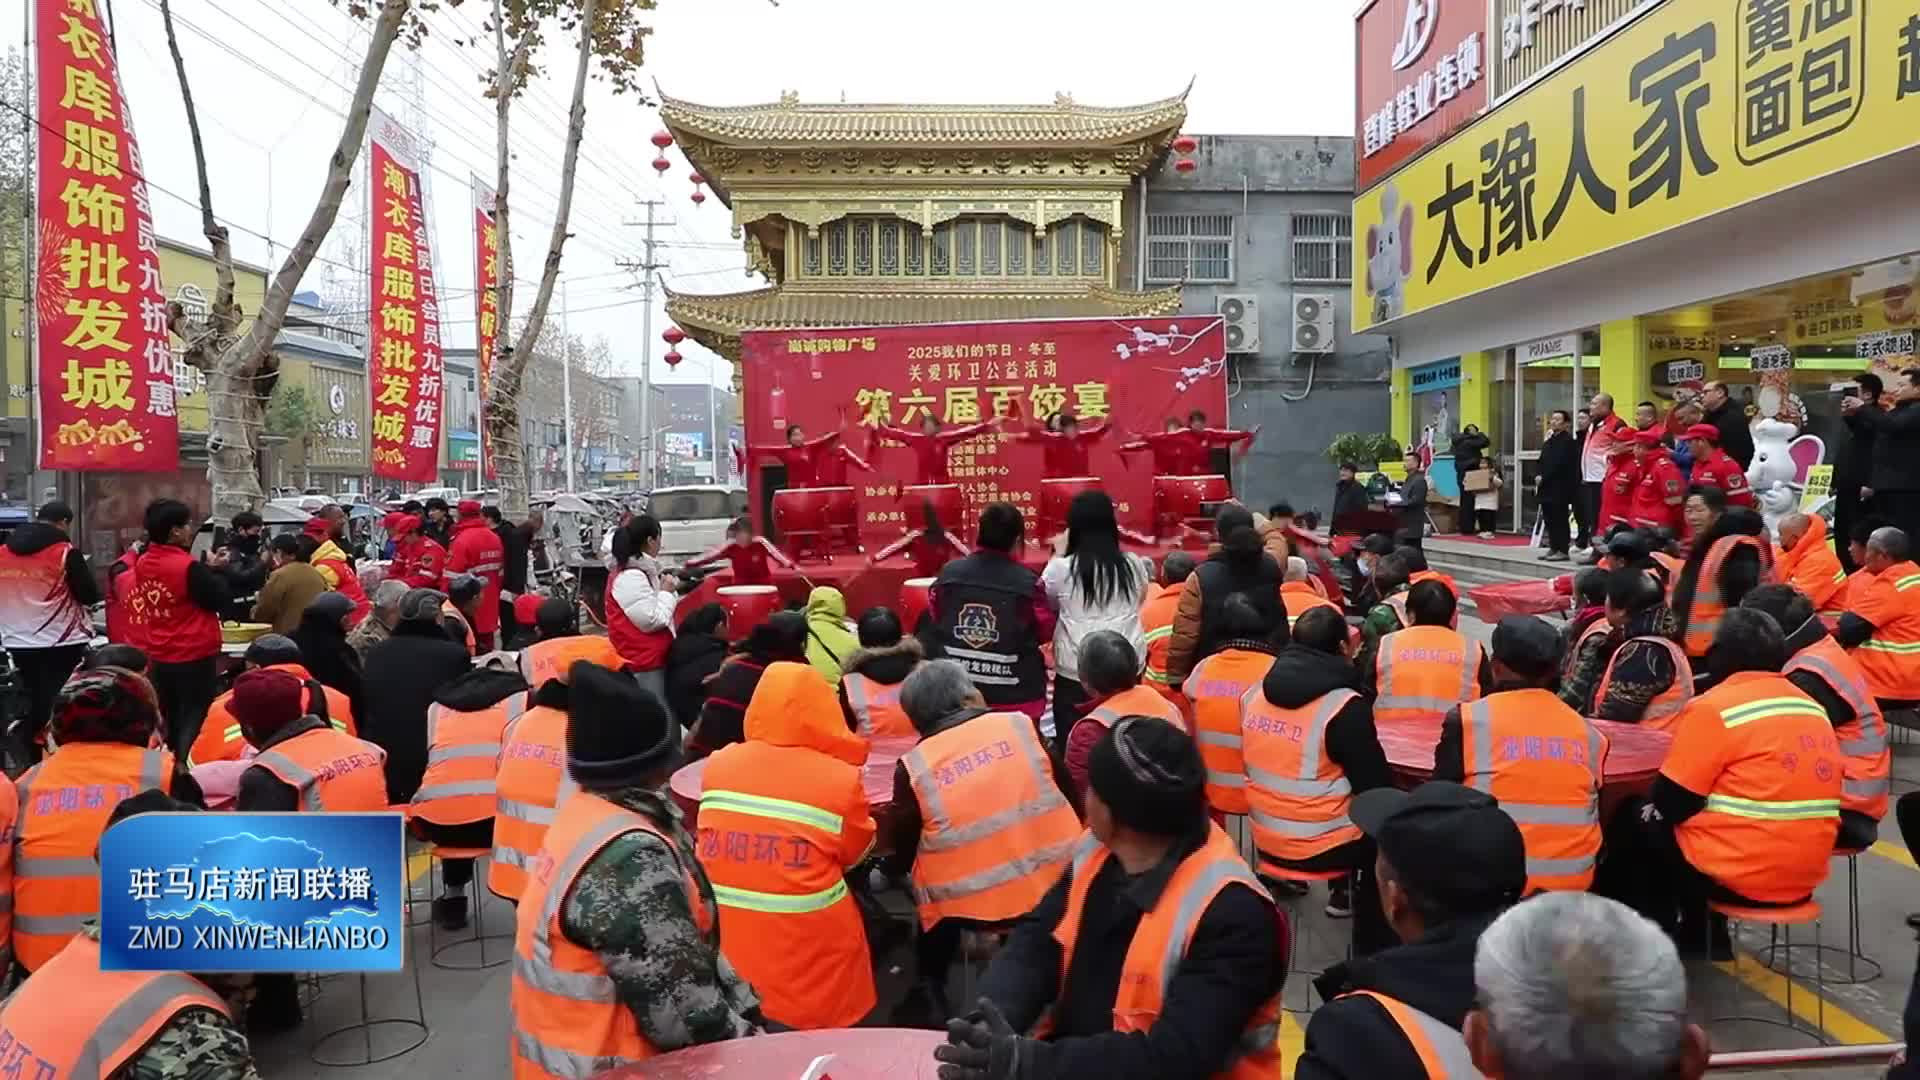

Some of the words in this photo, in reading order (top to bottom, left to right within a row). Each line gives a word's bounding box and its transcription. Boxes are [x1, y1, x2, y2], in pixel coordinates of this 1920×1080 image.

[1745, 35, 1853, 148] 面包
[1426, 21, 1719, 285] 大豫人家
[373, 160, 418, 445] 潮衣库服饰批发城
[908, 360, 1057, 382] 关爱环卫公益活动
[854, 381, 1111, 428] 第六届百饺宴
[936, 740, 1015, 786] 泌阳环卫
[702, 828, 814, 868] 泌阳环卫
